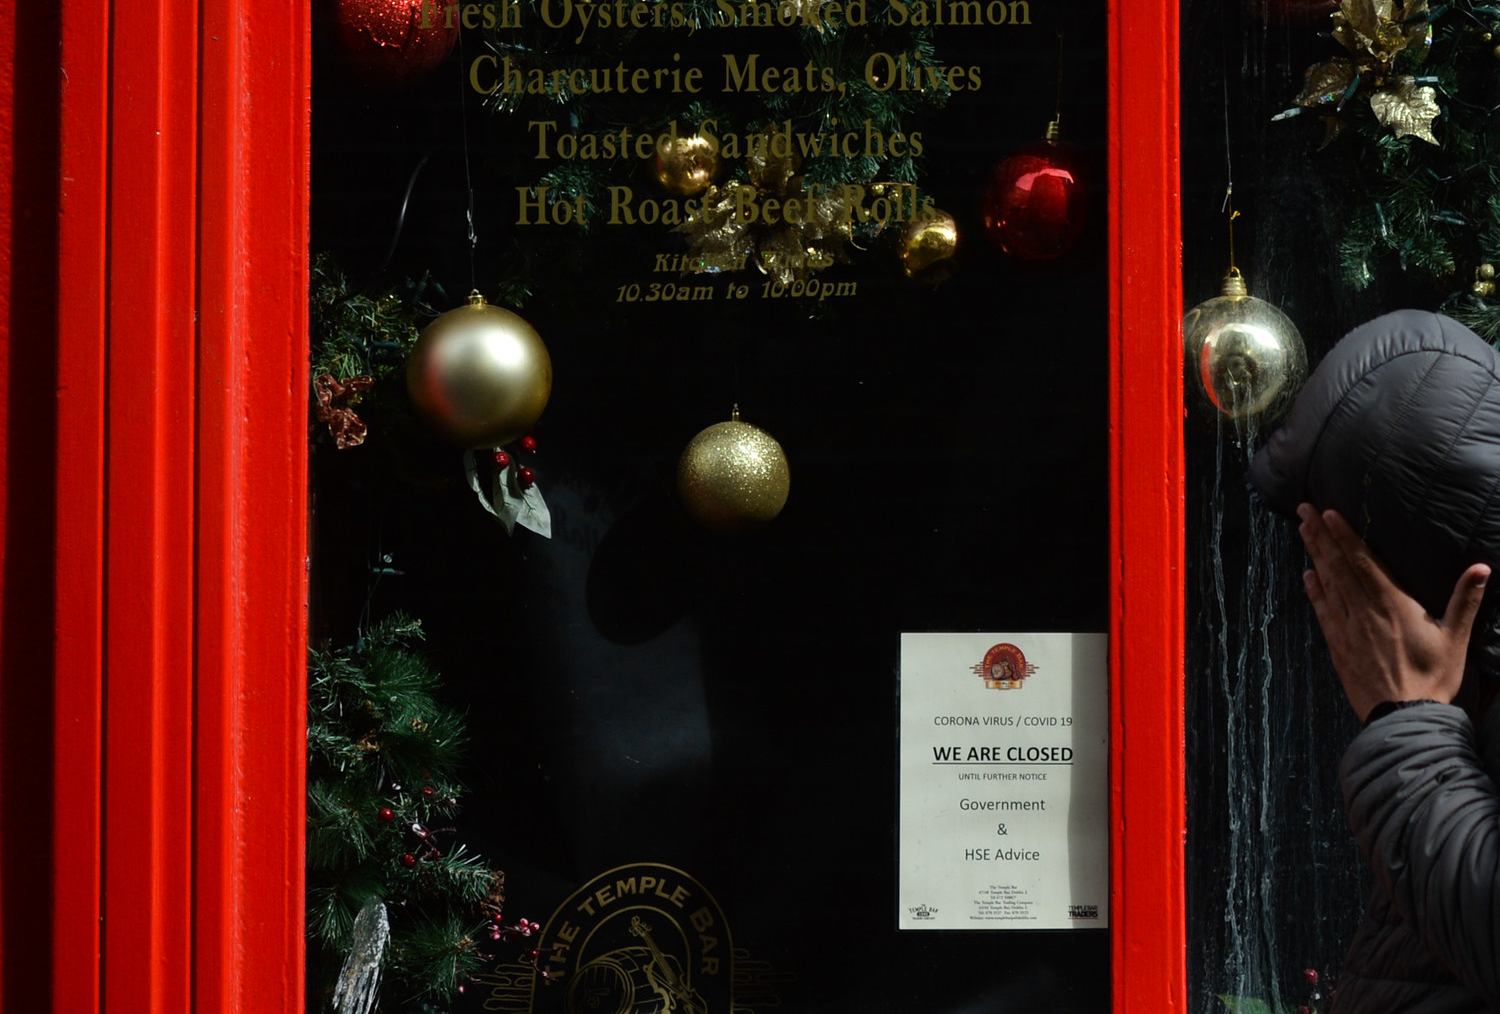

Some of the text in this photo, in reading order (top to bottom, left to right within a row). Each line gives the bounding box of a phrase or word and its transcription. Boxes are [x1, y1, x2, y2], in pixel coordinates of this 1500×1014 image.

[469, 51, 982, 100] Charcuterie Meats, Olives
[528, 117, 925, 161] Toasted Sandwiches
[515, 184, 937, 225] Hot Roast Beef Rolls
[615, 279, 858, 303] 10.30am to 10.00pm
[934, 716, 1073, 727] CORONA VIRUS / COVID 19
[933, 747, 1073, 761] WE ARE CLOSED
[958, 773, 1047, 781] UNTIL FURTHER NOTICE
[959, 798, 1046, 811] Government
[997, 823, 1008, 836] &
[965, 848, 1040, 861] HSE Advice
[543, 876, 720, 986] THE TEMPLE BAR
